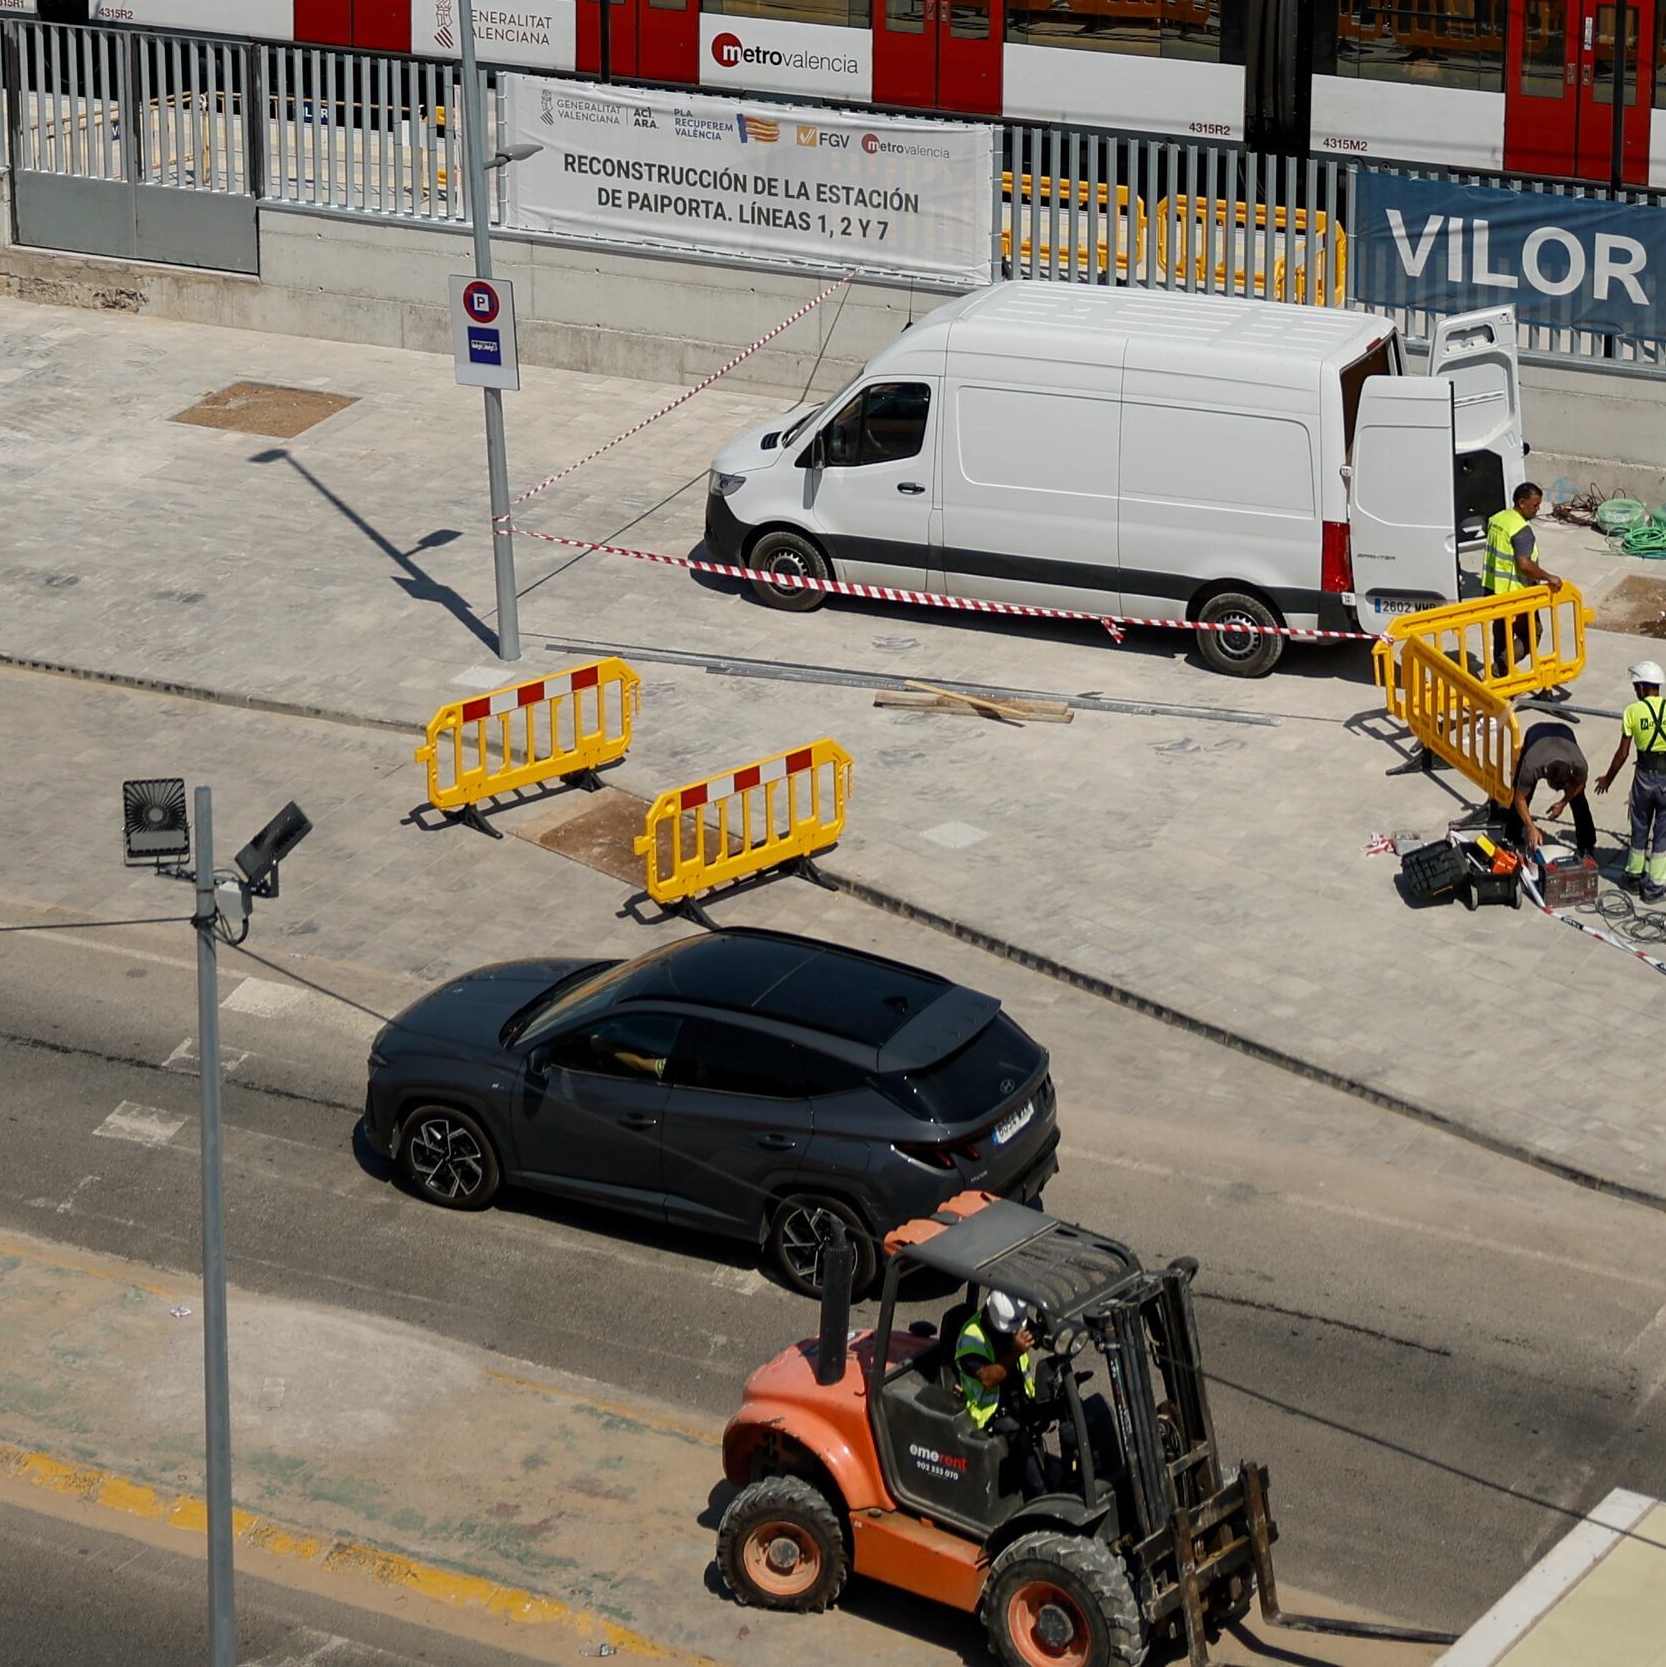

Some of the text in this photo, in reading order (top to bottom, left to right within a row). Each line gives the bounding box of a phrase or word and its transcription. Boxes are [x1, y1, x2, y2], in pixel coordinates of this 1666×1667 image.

[99, 7, 133, 20] 4315R2
[471, 9, 552, 29] ENERALITAT
[471, 26, 550, 45] ALENCIANA
[723, 46, 859, 74] metrovalencia
[557, 99, 621, 114] GENERALITAT
[674, 108, 693, 118] PLA
[558, 109, 620, 125] VALENCIANA
[634, 118, 660, 129] ARA.
[675, 118, 733, 132] RECUPEREM
[1188, 122, 1230, 135] 4315R2
[675, 126, 722, 141] VALÈNCIA
[819, 133, 850, 148] FGV
[868, 140, 950, 159] metrovalencia
[1323, 138, 1368, 151] 4315M2
[564, 153, 919, 213] RECONSTRUCCIÓN DE LA ESTACIÓN
[597, 187, 889, 240] DE PAIPORTA. LÍNEAS 1, 2 Y 7
[1386, 208, 1650, 306] VILOR
[476, 296, 485, 308] P
[1383, 600, 1411, 613] 2602
[909, 1444, 968, 1470] emerent
